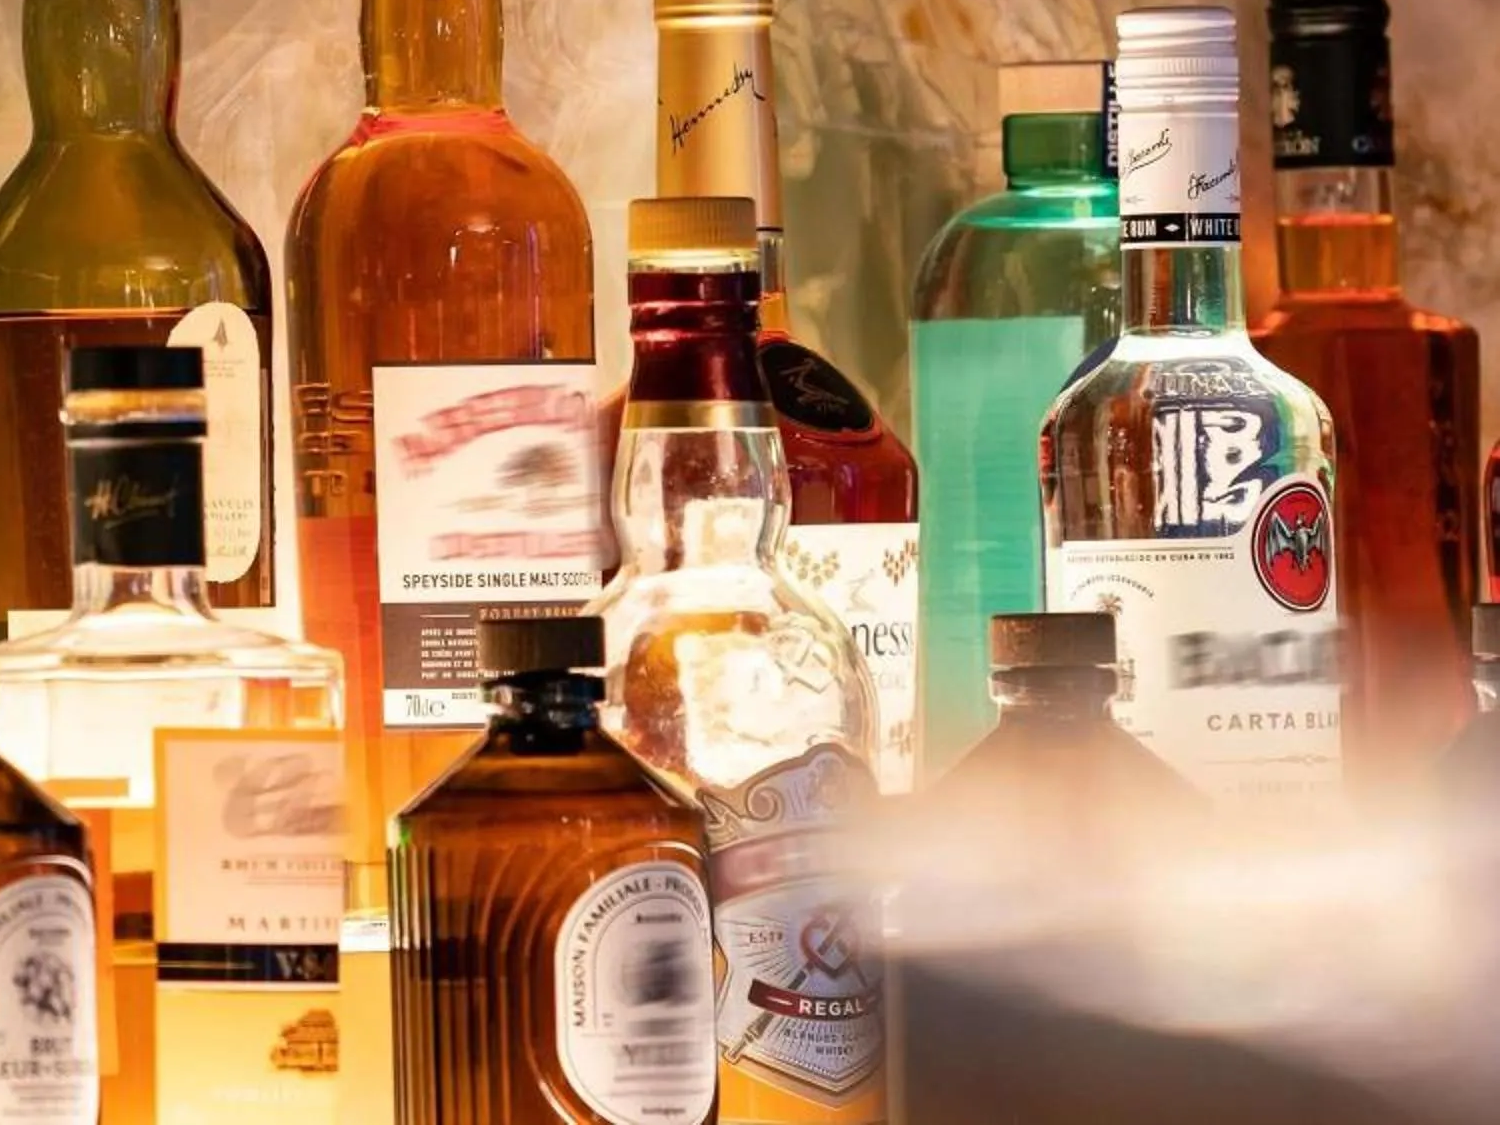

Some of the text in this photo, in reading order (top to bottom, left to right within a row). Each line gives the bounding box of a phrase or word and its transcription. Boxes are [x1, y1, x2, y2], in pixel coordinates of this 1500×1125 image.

[402, 573, 473, 589] SPEYSIDE
[477, 573, 526, 588] SINGLE
[529, 572, 559, 587] MALT
[1206, 713, 1297, 732] CARTA
[572, 877, 650, 1027] MAISON FAMILIALE
[799, 998, 863, 1016] REGAL
